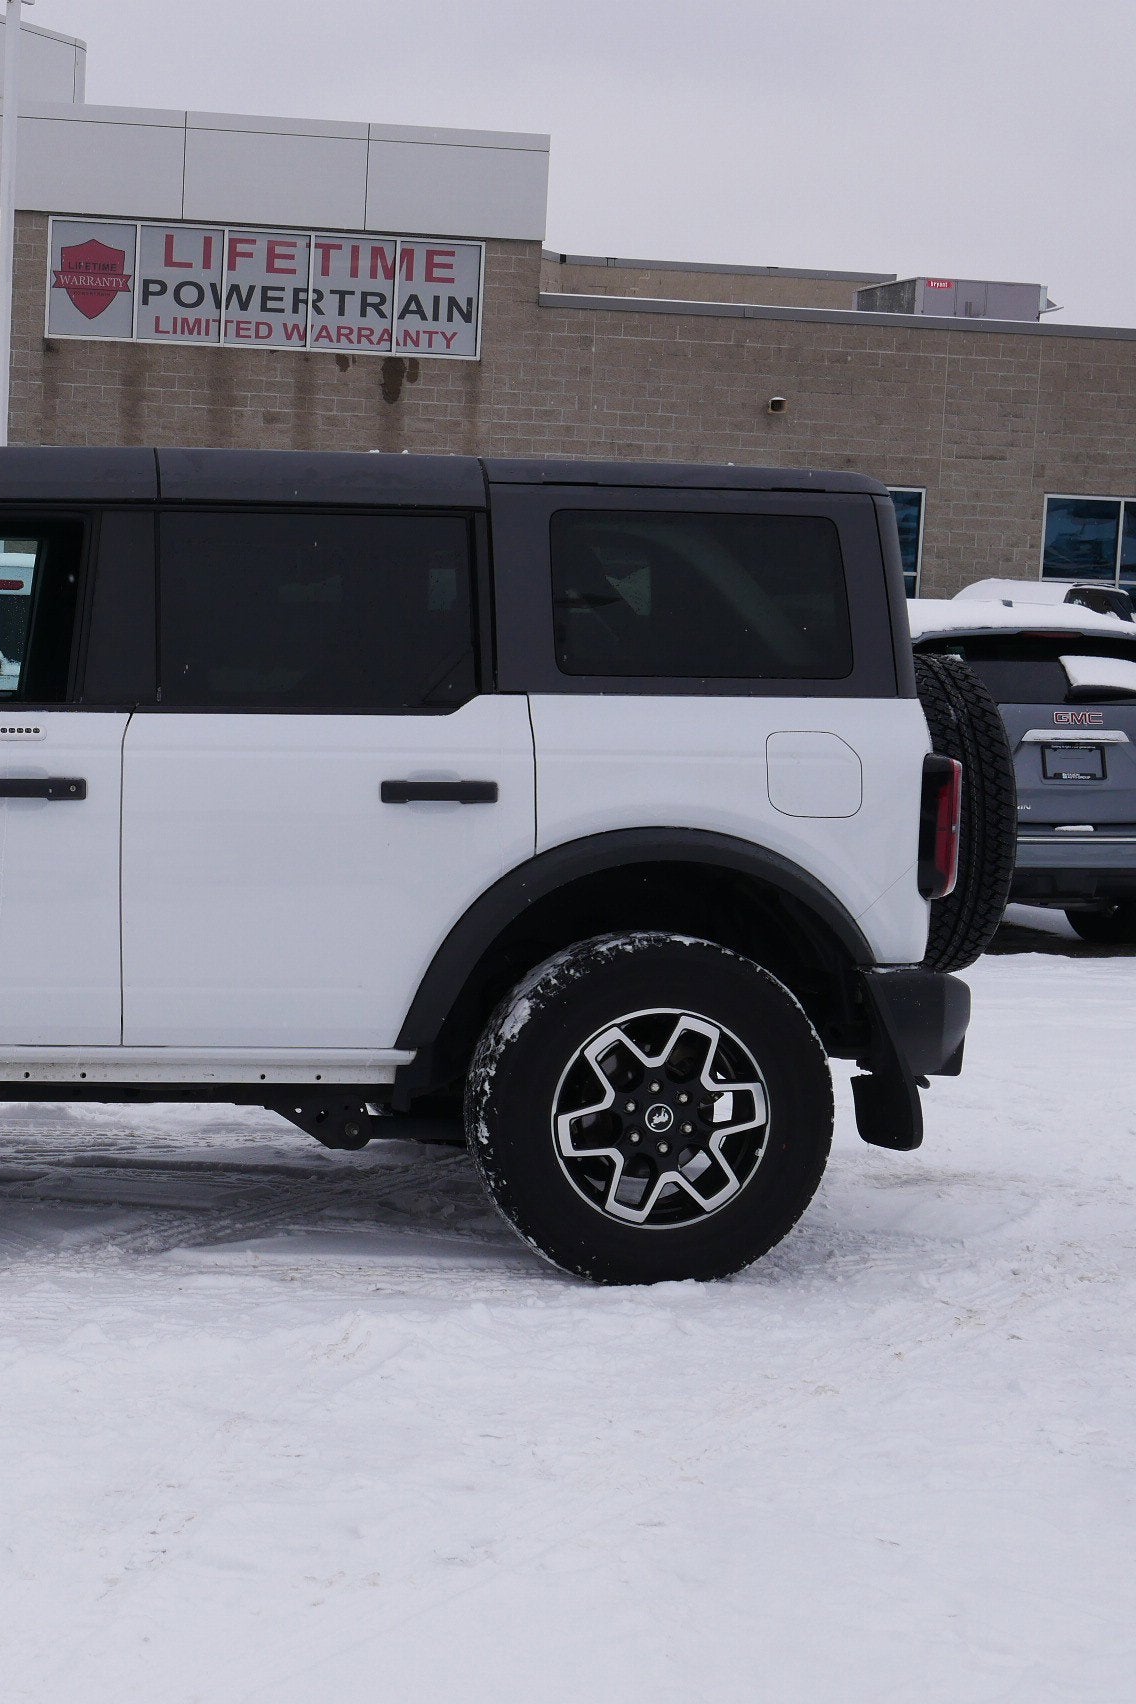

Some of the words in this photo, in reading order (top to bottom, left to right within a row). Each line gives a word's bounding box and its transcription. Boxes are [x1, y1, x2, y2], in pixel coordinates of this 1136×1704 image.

[68, 261, 117, 272] LIFETIME
[164, 233, 456, 284] LIFETIME
[59, 274, 126, 288] WARRANTY
[141, 278, 474, 324] POWERTRAIN
[154, 315, 274, 340] LIMITED
[282, 323, 459, 350] WARRANTY
[1054, 711, 1104, 725] GMC
